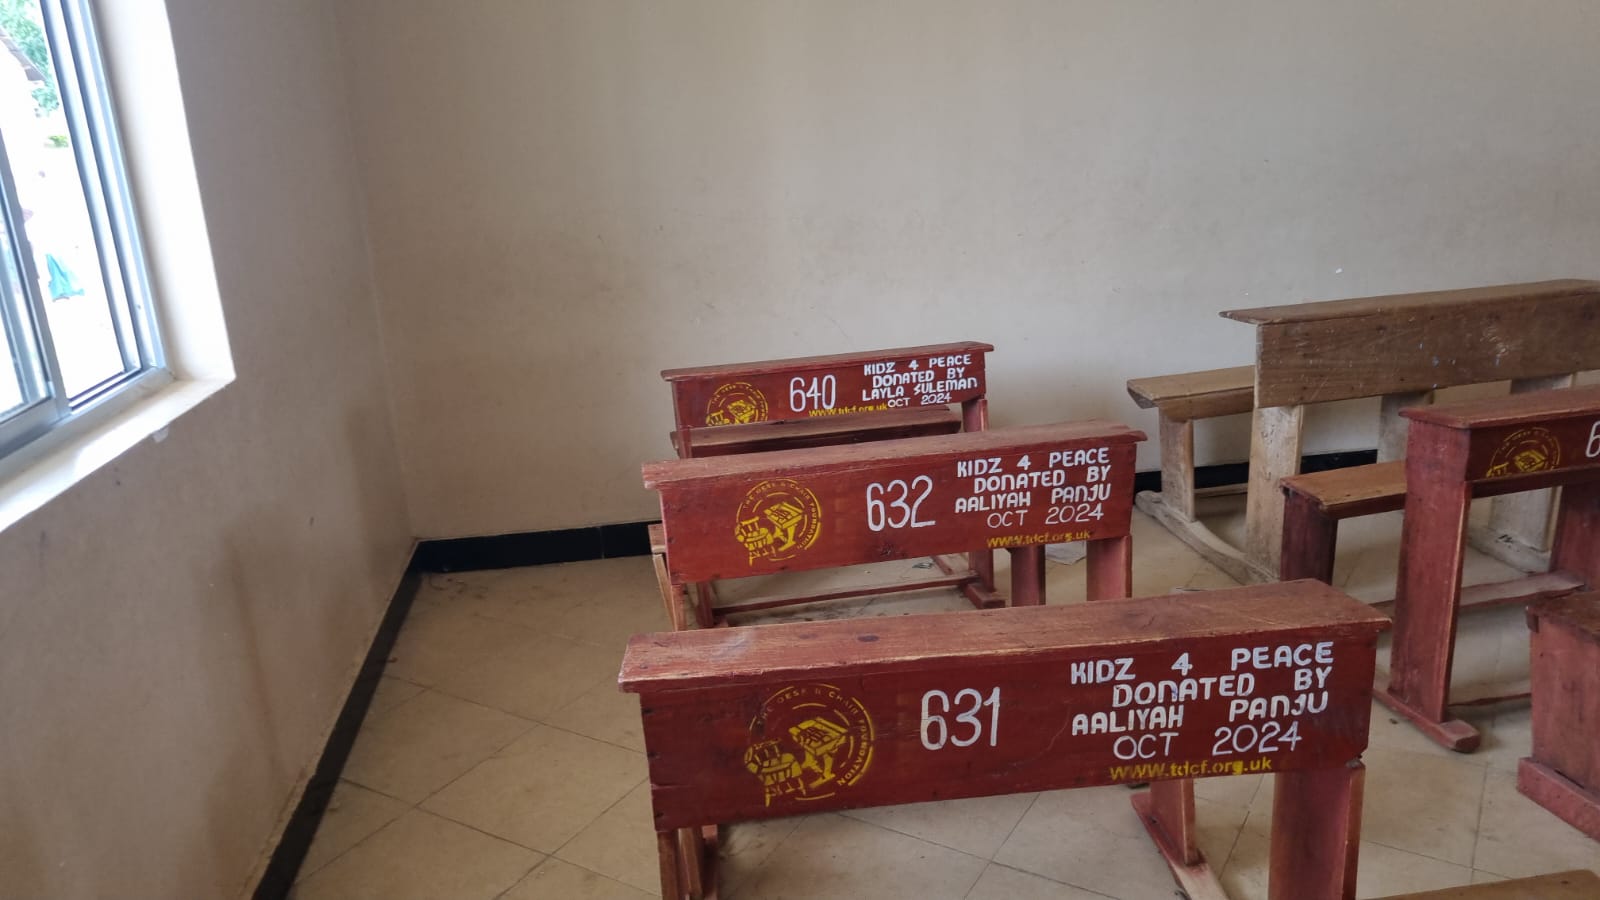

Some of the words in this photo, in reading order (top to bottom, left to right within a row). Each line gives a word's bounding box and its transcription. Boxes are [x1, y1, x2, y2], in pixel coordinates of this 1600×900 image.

[863, 362, 896, 376] KIDZ
[908, 360, 919, 370] 4
[929, 354, 972, 368] PEACE
[872, 370, 935, 388] DONATED
[947, 367, 965, 380] BY
[790, 375, 836, 412] 640
[862, 386, 905, 401] LAYLA
[913, 377, 978, 395] SULEMAN
[887, 398, 911, 408] OCT
[920, 392, 952, 405] 2024
[957, 458, 1003, 478] KIDZ
[1016, 455, 1031, 471] 4
[1049, 447, 1110, 468] PEACE
[973, 469, 1066, 494] DONATED
[1086, 465, 1111, 483] BY
[866, 474, 936, 531] 632
[955, 491, 1031, 513] AALIYAH
[1051, 483, 1111, 504] PANJU
[987, 510, 1029, 528] OCT
[1045, 503, 1104, 525] 2024
[1071, 658, 1136, 684] KIDZ
[1171, 652, 1193, 676] 4
[1231, 641, 1334, 671] PEACE
[1112, 673, 1255, 708] DONATED
[1294, 666, 1332, 691] BY
[920, 686, 1000, 750] 631
[1071, 705, 1185, 736] AALIYAH
[1229, 691, 1329, 722] PANJU
[1113, 732, 1179, 760] OCT
[1212, 721, 1302, 756] 2024
